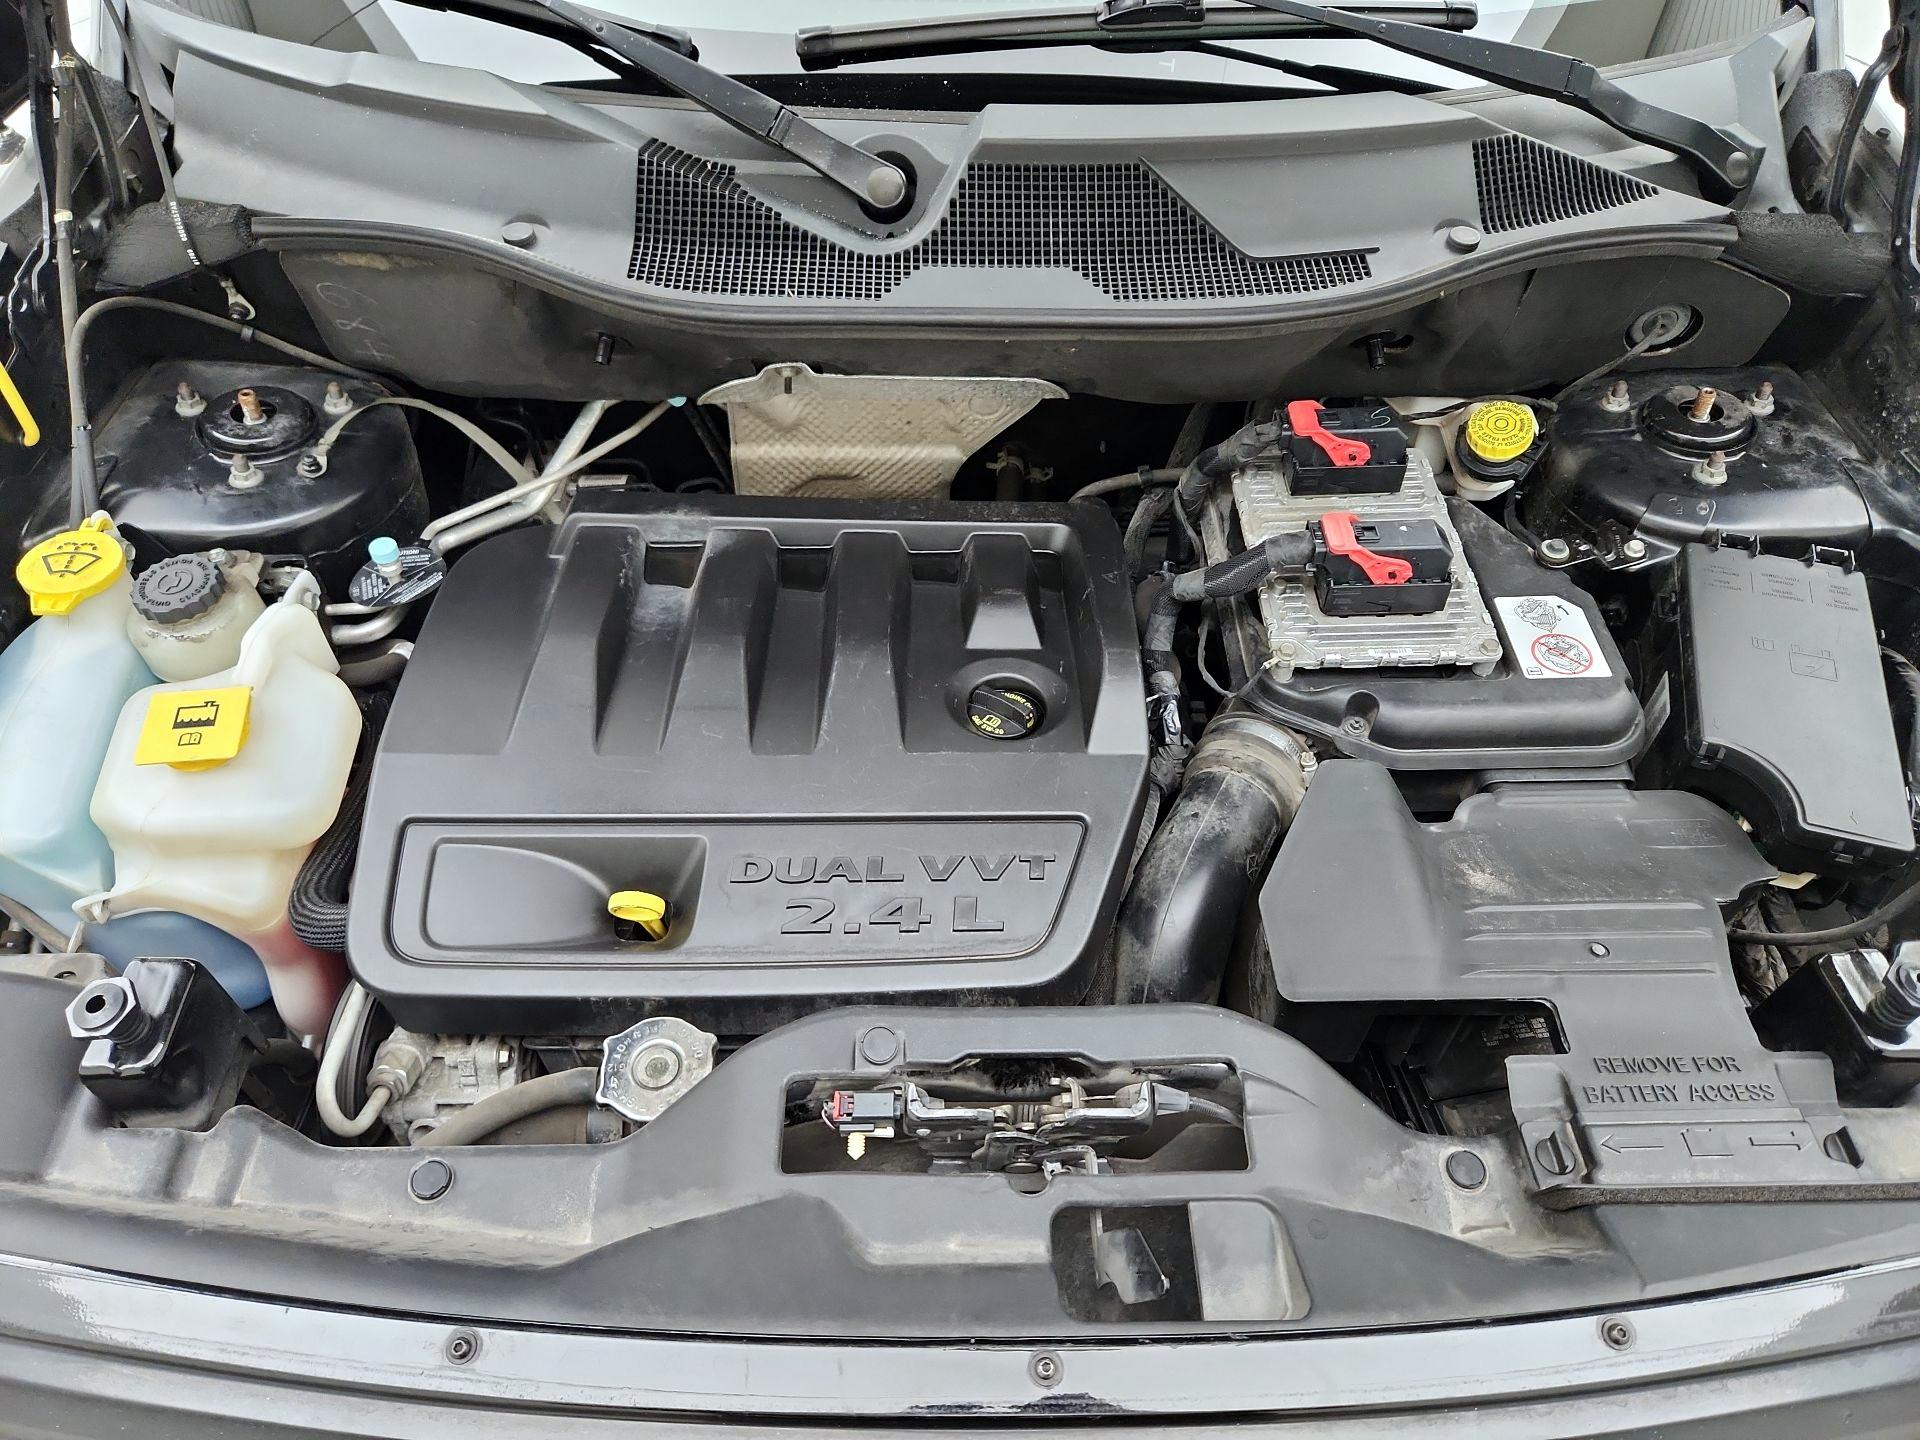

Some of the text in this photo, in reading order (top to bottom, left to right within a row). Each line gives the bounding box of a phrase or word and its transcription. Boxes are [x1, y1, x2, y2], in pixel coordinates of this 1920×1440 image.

[971, 714, 1005, 735] SAE 5W-20
[730, 855, 1056, 884] DUAL VVT
[607, 1063, 626, 1072] G12
[1593, 1055, 1743, 1074] REMOVE FOR
[1583, 1083, 1776, 1104] BATTERY ACCESS
